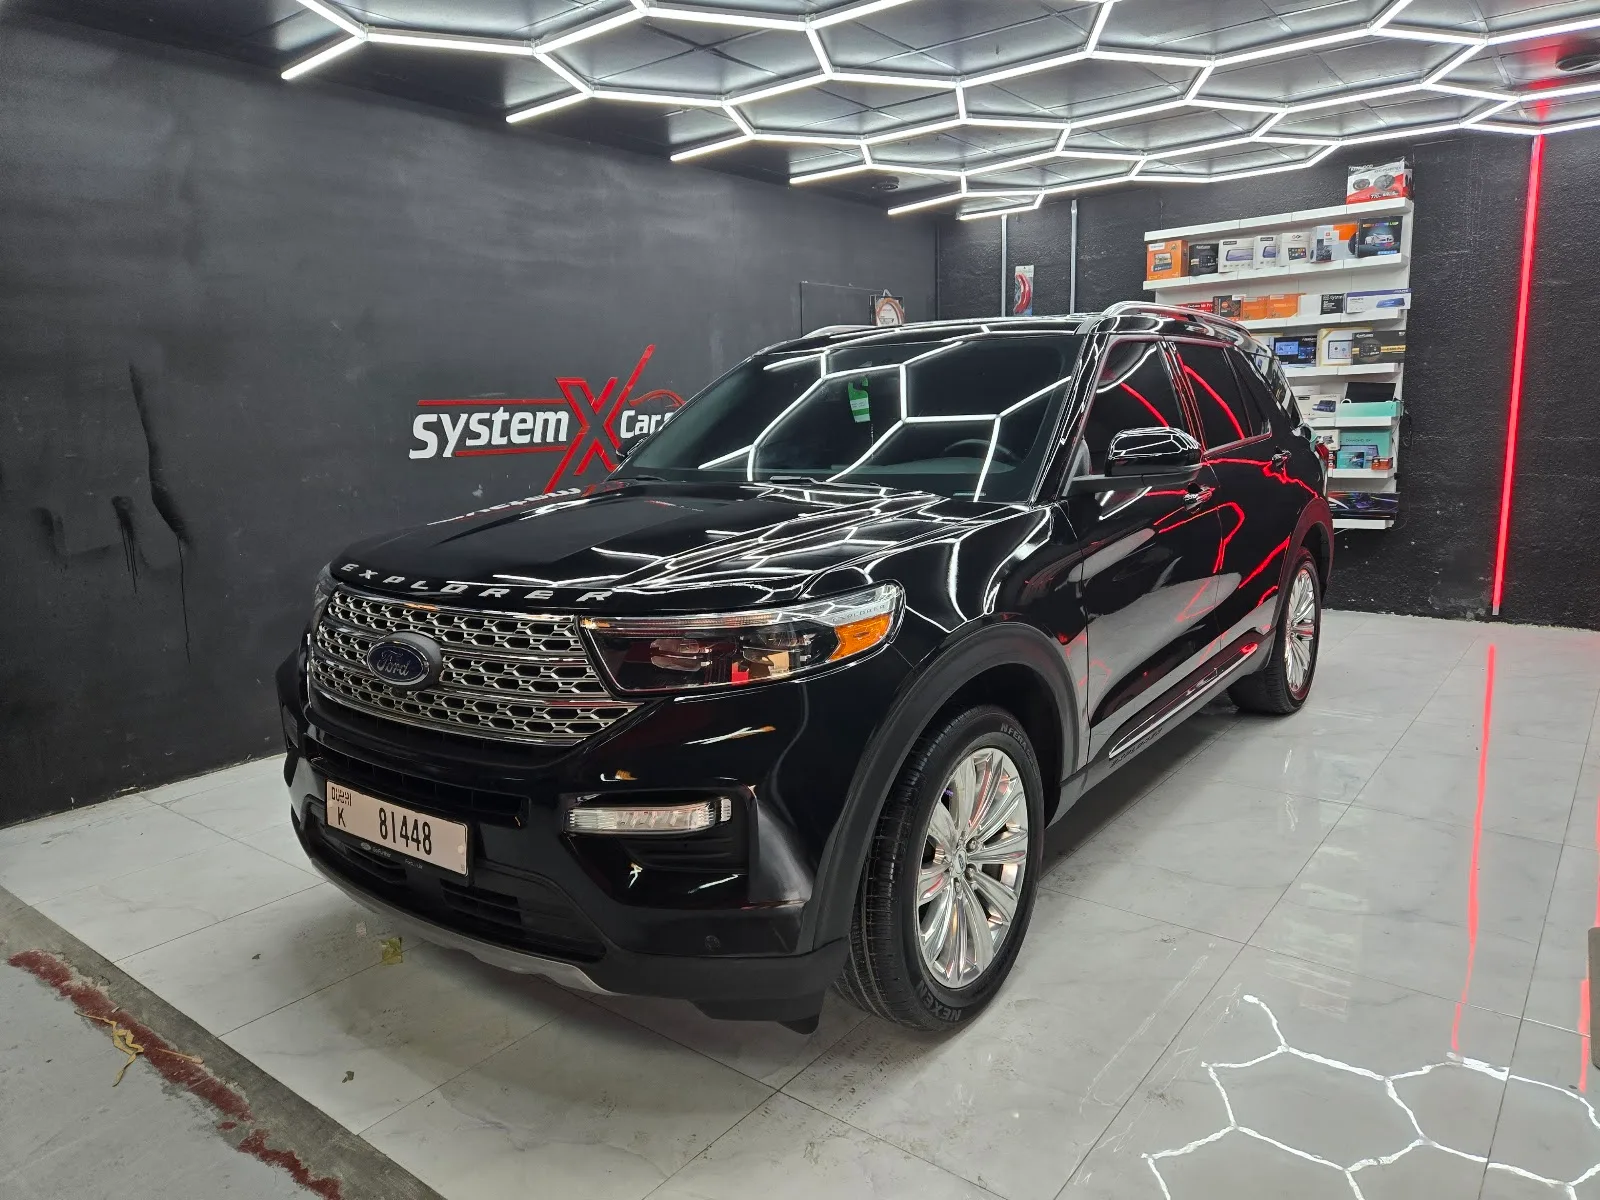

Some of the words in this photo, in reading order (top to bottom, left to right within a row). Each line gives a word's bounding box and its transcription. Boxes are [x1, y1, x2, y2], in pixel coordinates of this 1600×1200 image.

[408, 406, 569, 459] System
[543, 344, 656, 495] X
[340, 563, 613, 602] EXPLORER
[376, 649, 411, 677] Ford
[337, 806, 346, 828] K
[378, 807, 432, 856] 81448
